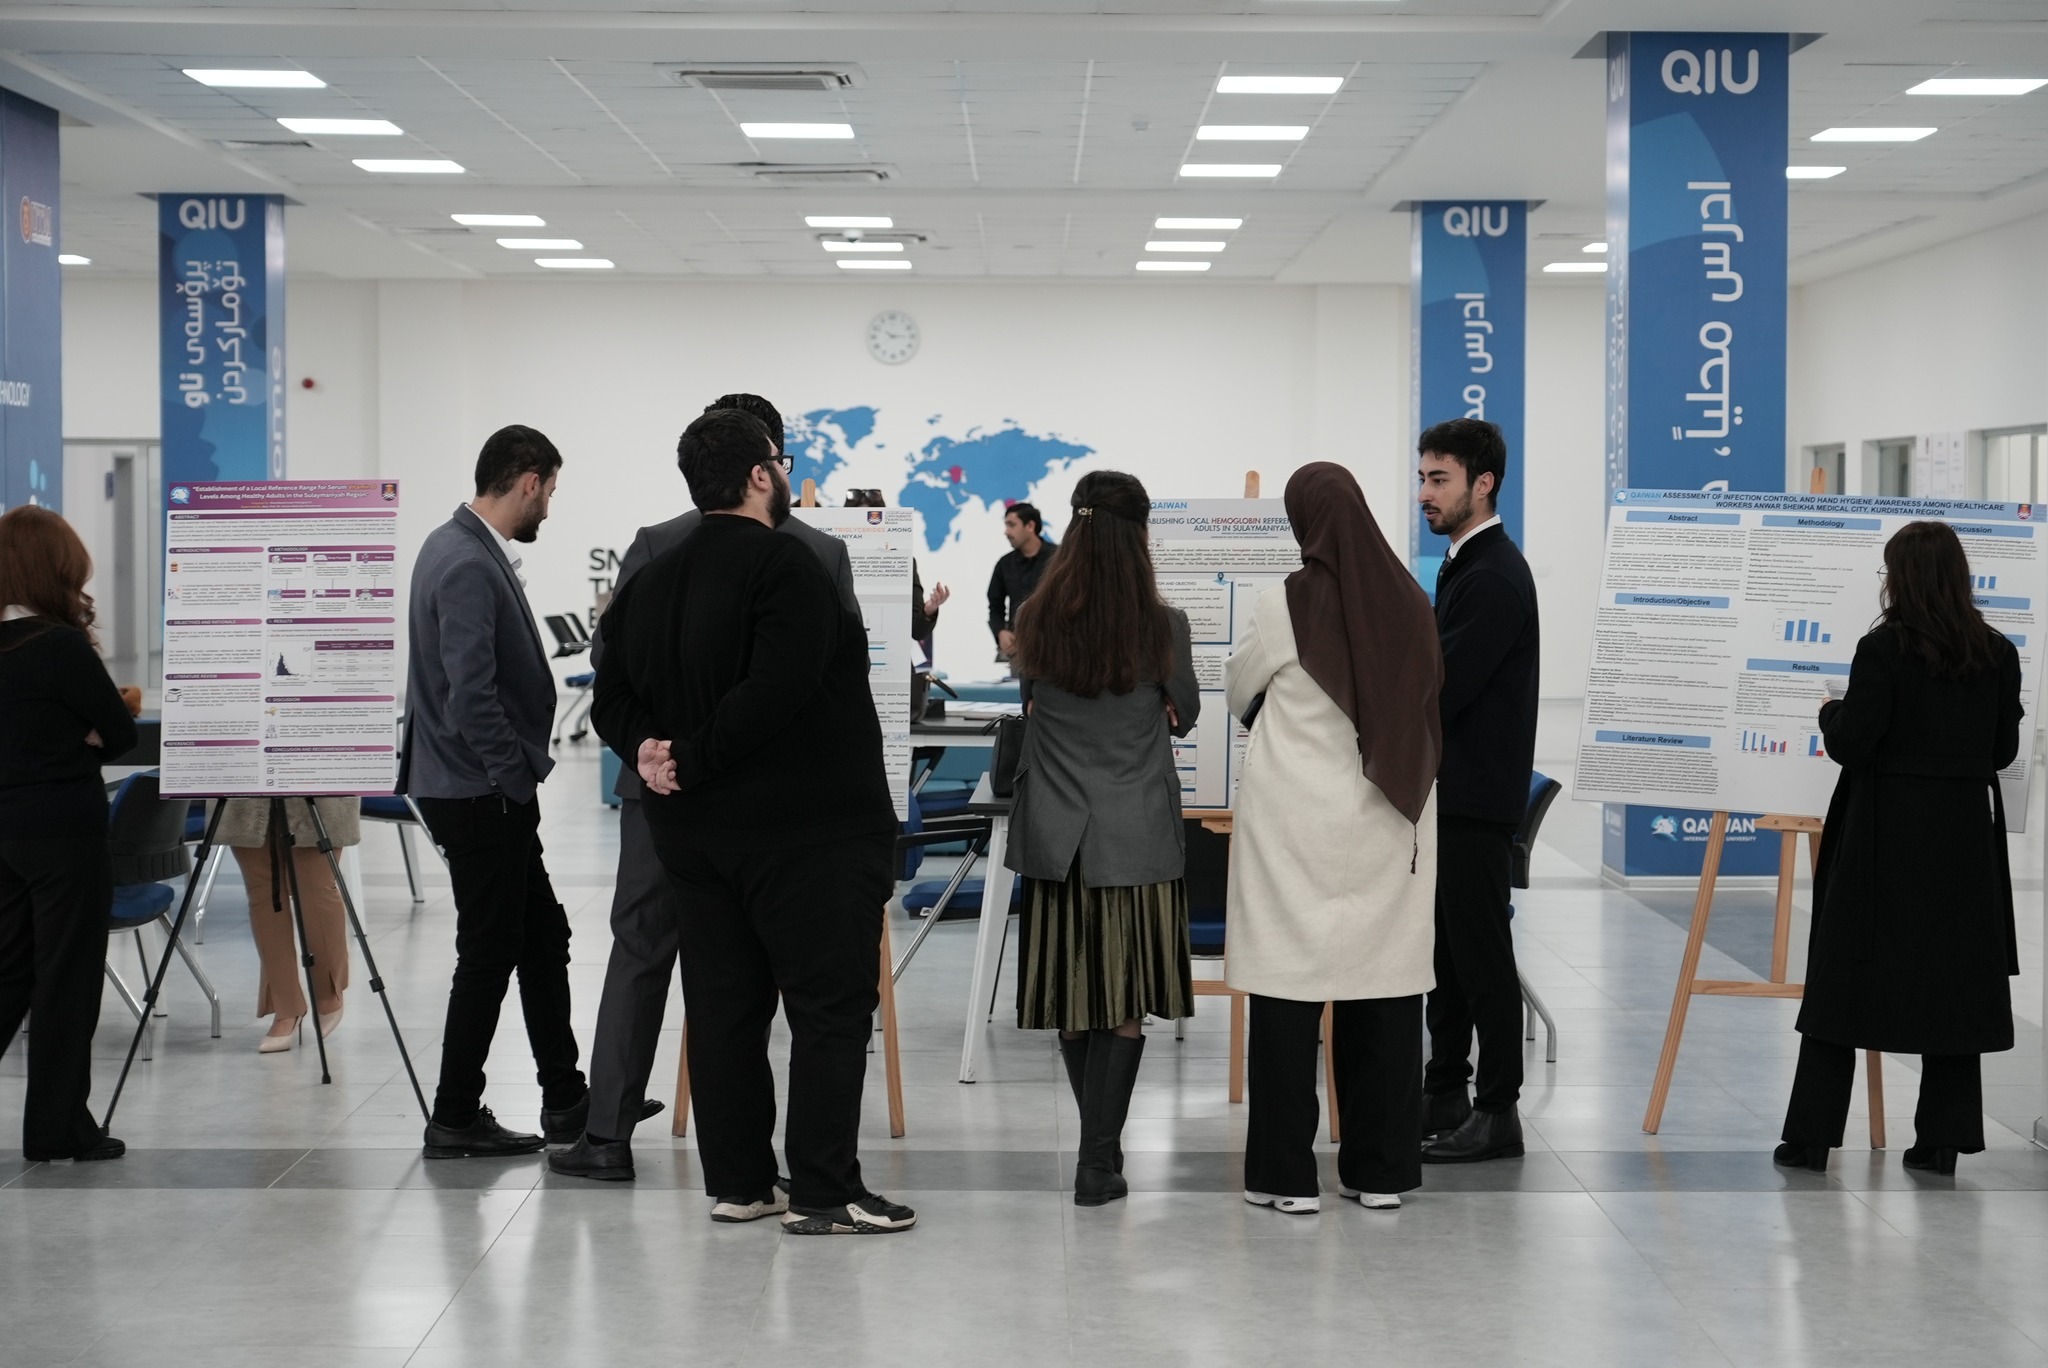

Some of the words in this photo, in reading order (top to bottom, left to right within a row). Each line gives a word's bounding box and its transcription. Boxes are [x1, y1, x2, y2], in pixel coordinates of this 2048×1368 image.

[1661, 48, 1759, 95] QIU
[179, 198, 245, 230] QIU
[1443, 205, 1509, 237] QIU
[1687, 181, 1744, 302] ادرس
[1455, 292, 1494, 374] ادرس
[178, 372, 209, 408] ناو
[1662, 492, 1710, 500] ASSESSMENT
[1840, 497, 1873, 505] HYGIENE
[1874, 499, 1921, 508] AWARENESS
[1923, 501, 1951, 509] AMONG
[1953, 502, 2005, 511] HEALTHCARE
[1716, 501, 1752, 509] WORKERS
[1753, 502, 1781, 510] ANWAR
[1782, 503, 1814, 511] SHEIKHA
[1851, 505, 1869, 514] CITY,
[1871, 506, 1913, 515] KURDISTAN
[1915, 508, 1945, 516] REGION
[1668, 514, 1698, 522] Abstract
[1797, 518, 1845, 529] Methodology
[1633, 596, 1711, 606] Introduction/Objective
[1792, 663, 1820, 672] Results
[1622, 734, 1657, 743] Literature
[1658, 736, 1684, 745] Review
[1682, 817, 1756, 834] QAAN
[850, 1206, 863, 1216] AIR
